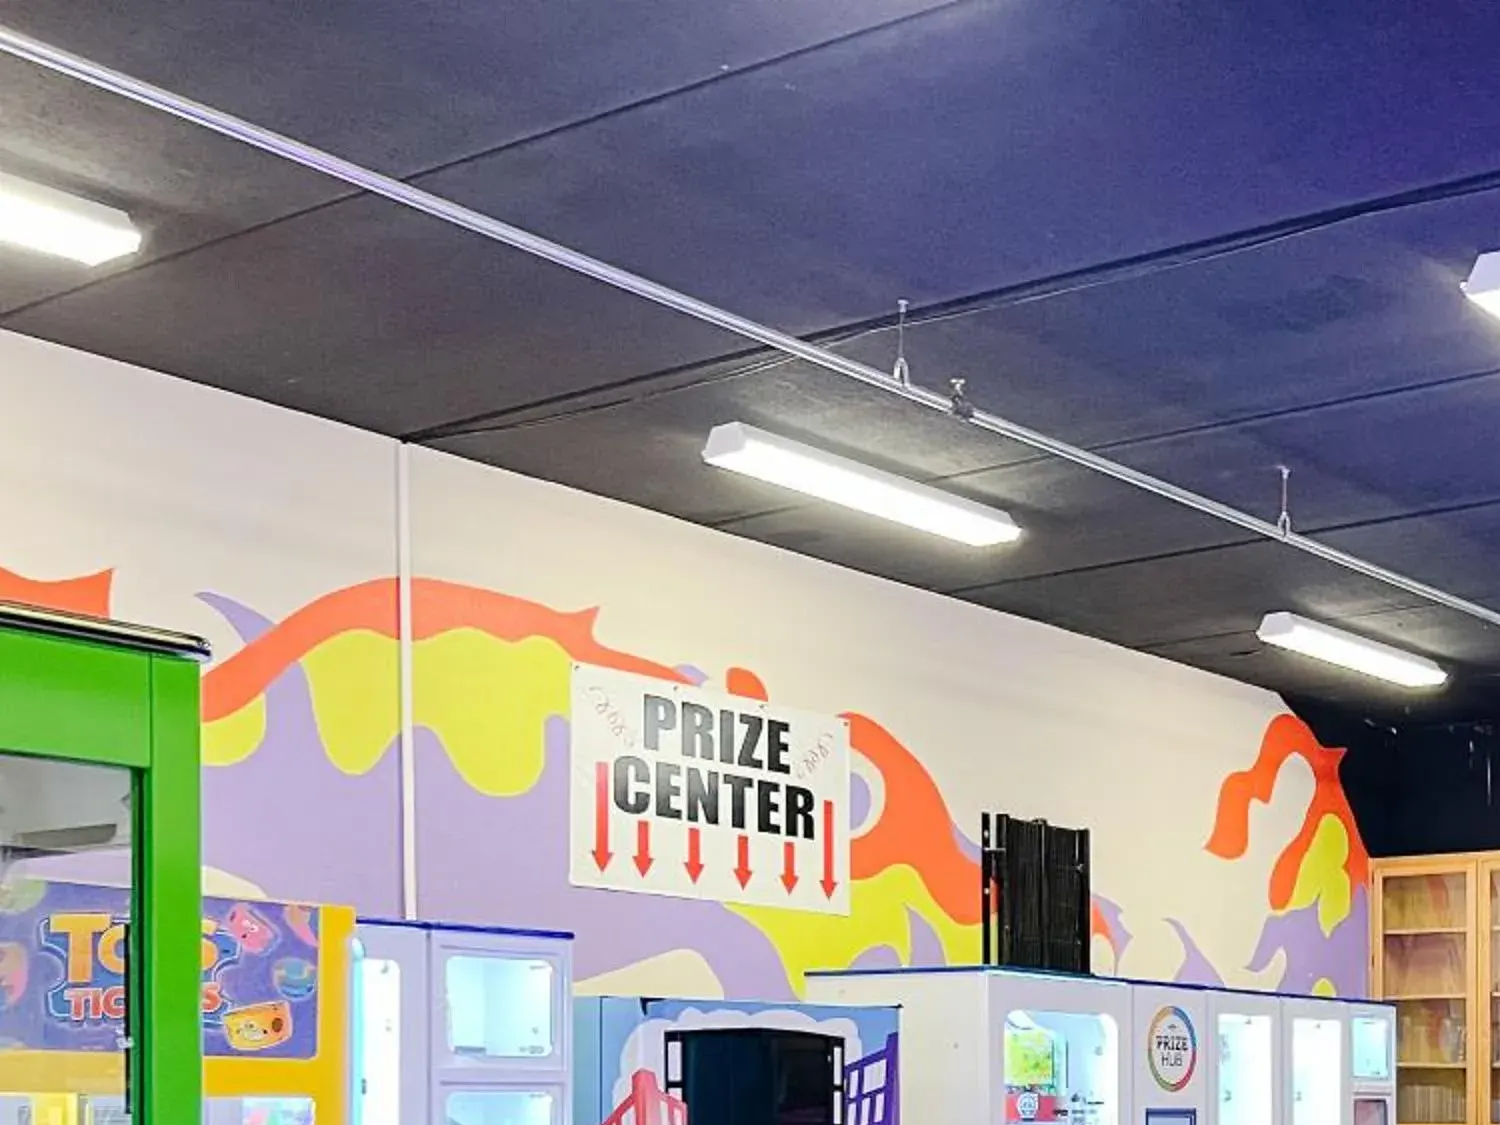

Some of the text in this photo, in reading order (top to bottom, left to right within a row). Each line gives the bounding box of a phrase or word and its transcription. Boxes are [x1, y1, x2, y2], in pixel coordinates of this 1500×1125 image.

[643, 692, 791, 775] PRIZE
[612, 755, 815, 840] CENTER
[1156, 1035, 1188, 1051] PRIZE
[1161, 1052, 1183, 1067] HUB
